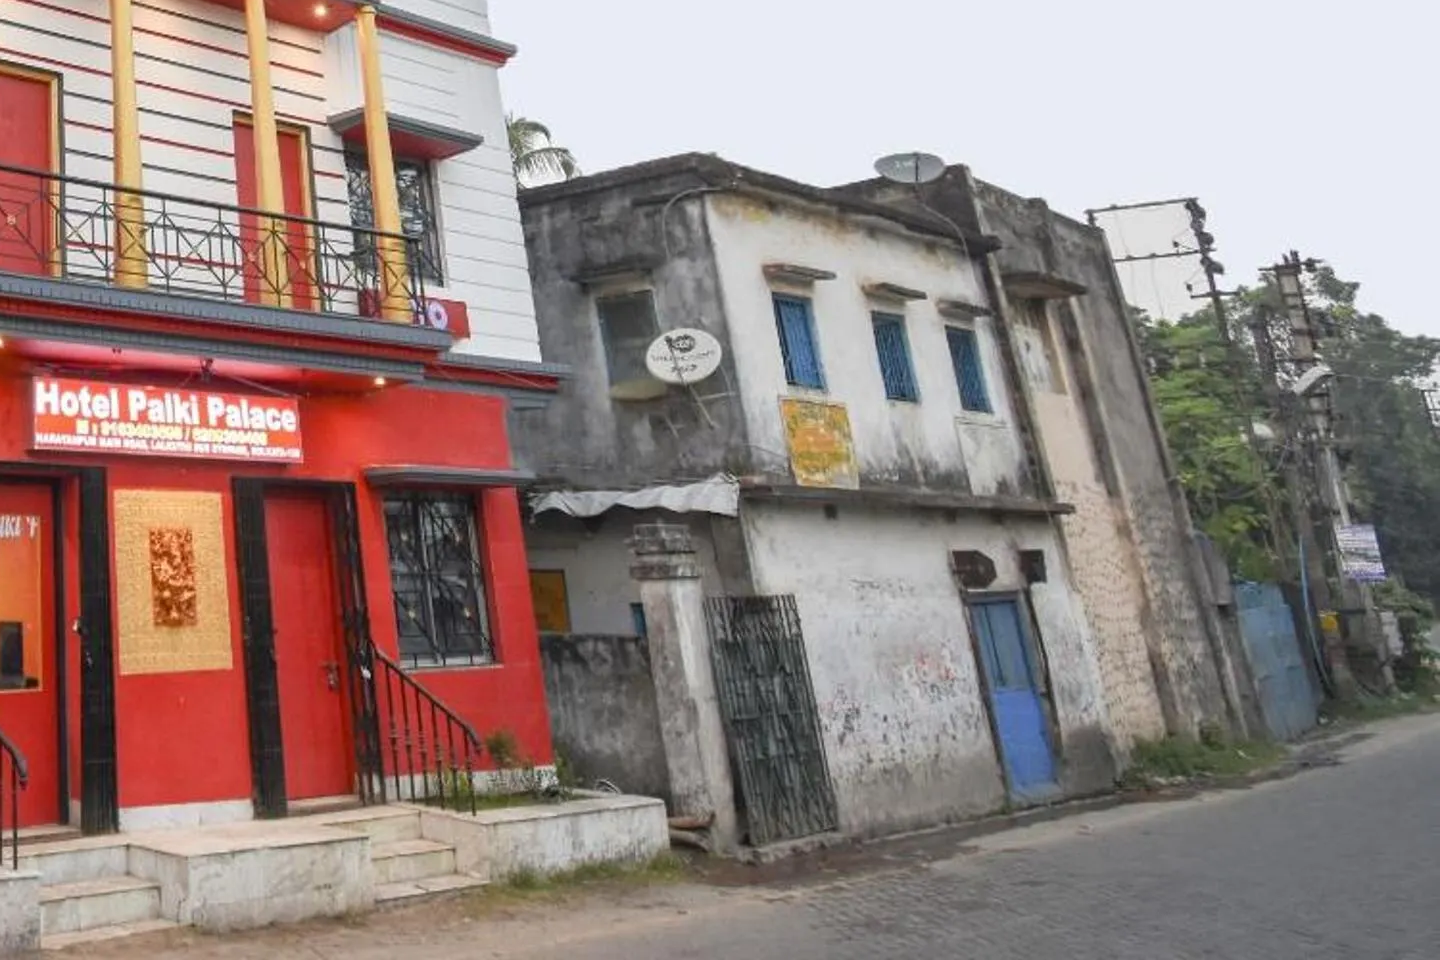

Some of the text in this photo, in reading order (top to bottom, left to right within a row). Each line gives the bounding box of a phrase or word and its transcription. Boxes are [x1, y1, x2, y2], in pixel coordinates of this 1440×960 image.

[35, 381, 119, 419] Hotel
[128, 388, 200, 425] Palki
[206, 395, 297, 432] Palace
